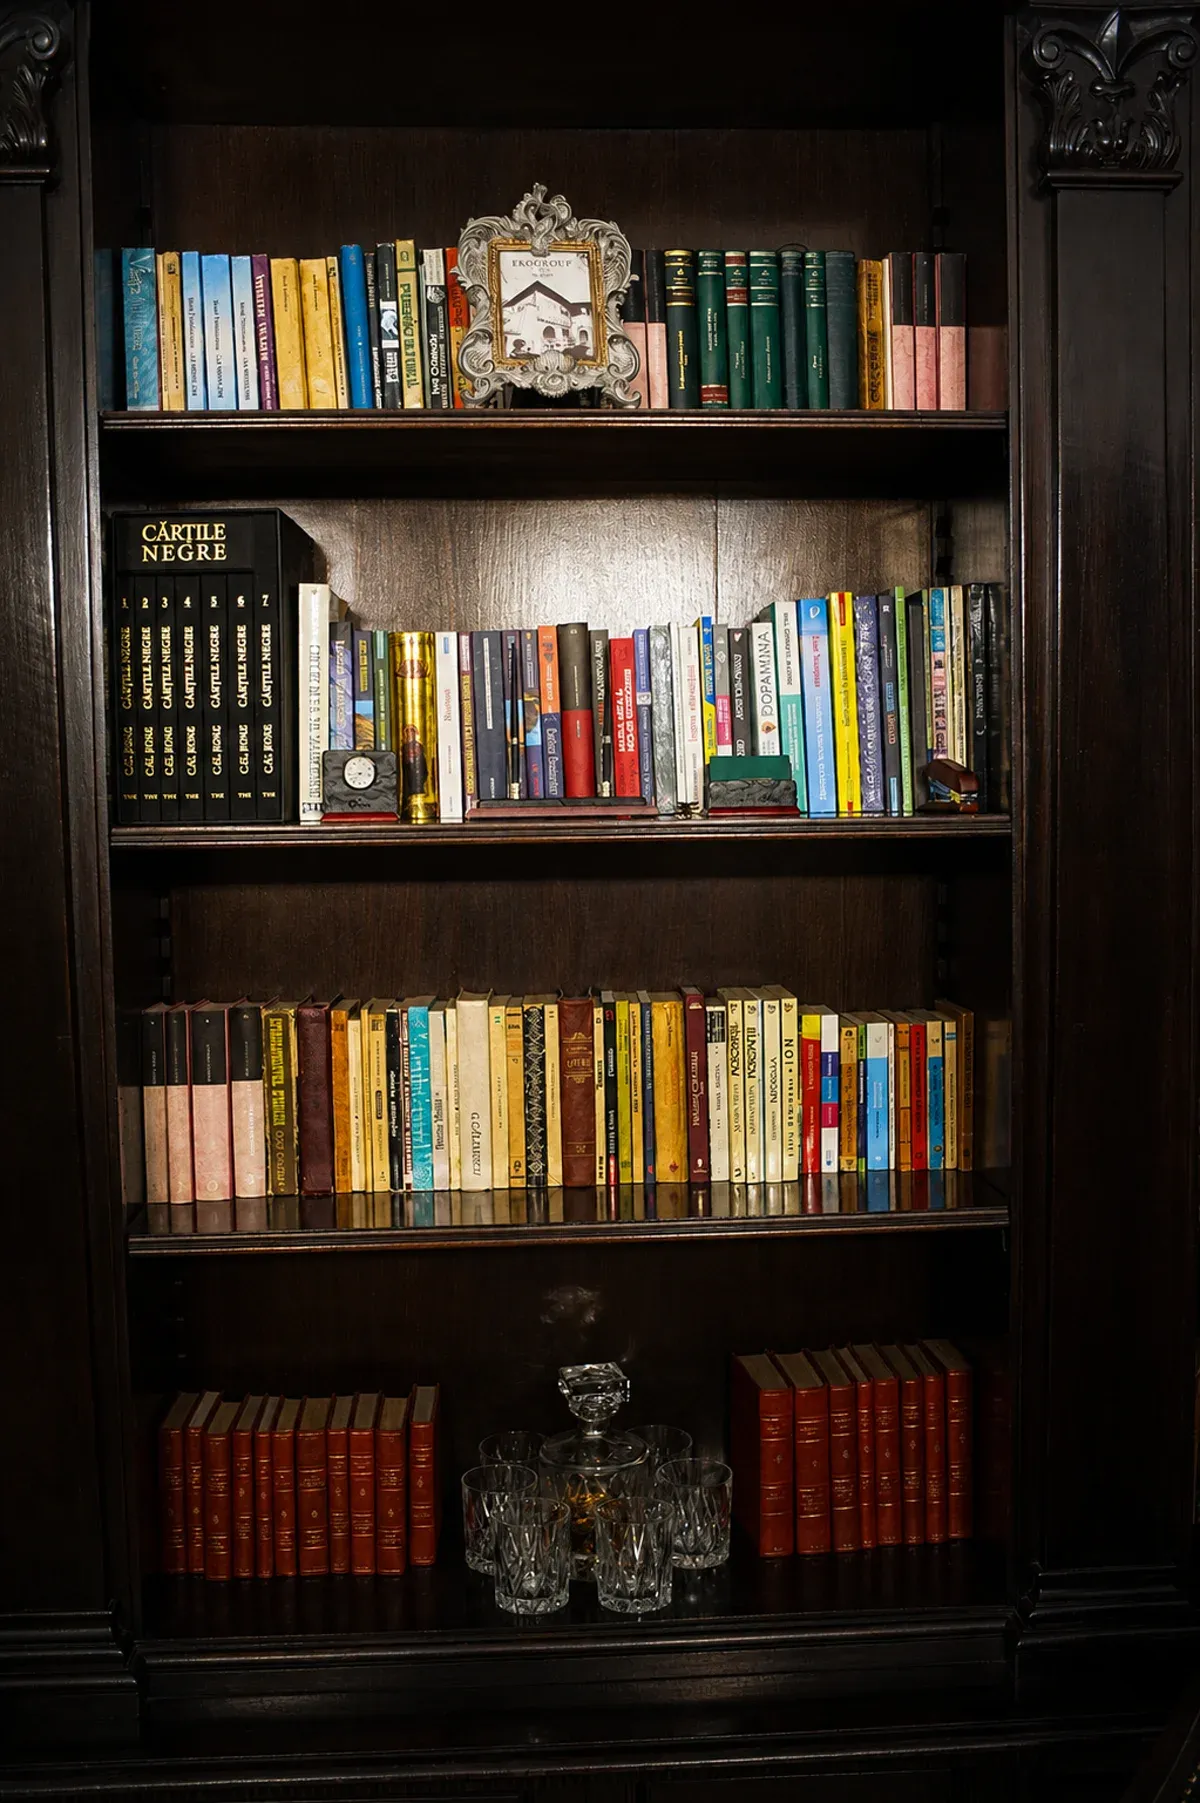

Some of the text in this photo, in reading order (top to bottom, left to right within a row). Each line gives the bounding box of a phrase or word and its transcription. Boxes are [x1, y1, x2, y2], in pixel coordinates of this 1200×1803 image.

[142, 544, 227, 562] NEGRE
[142, 597, 149, 609] 2
[162, 597, 168, 609] 3
[184, 596, 191, 608] 4
[211, 596, 218, 608] 5
[237, 596, 245, 607] 6
[262, 595, 269, 607] 7
[758, 631, 775, 717] DOPAMINA
